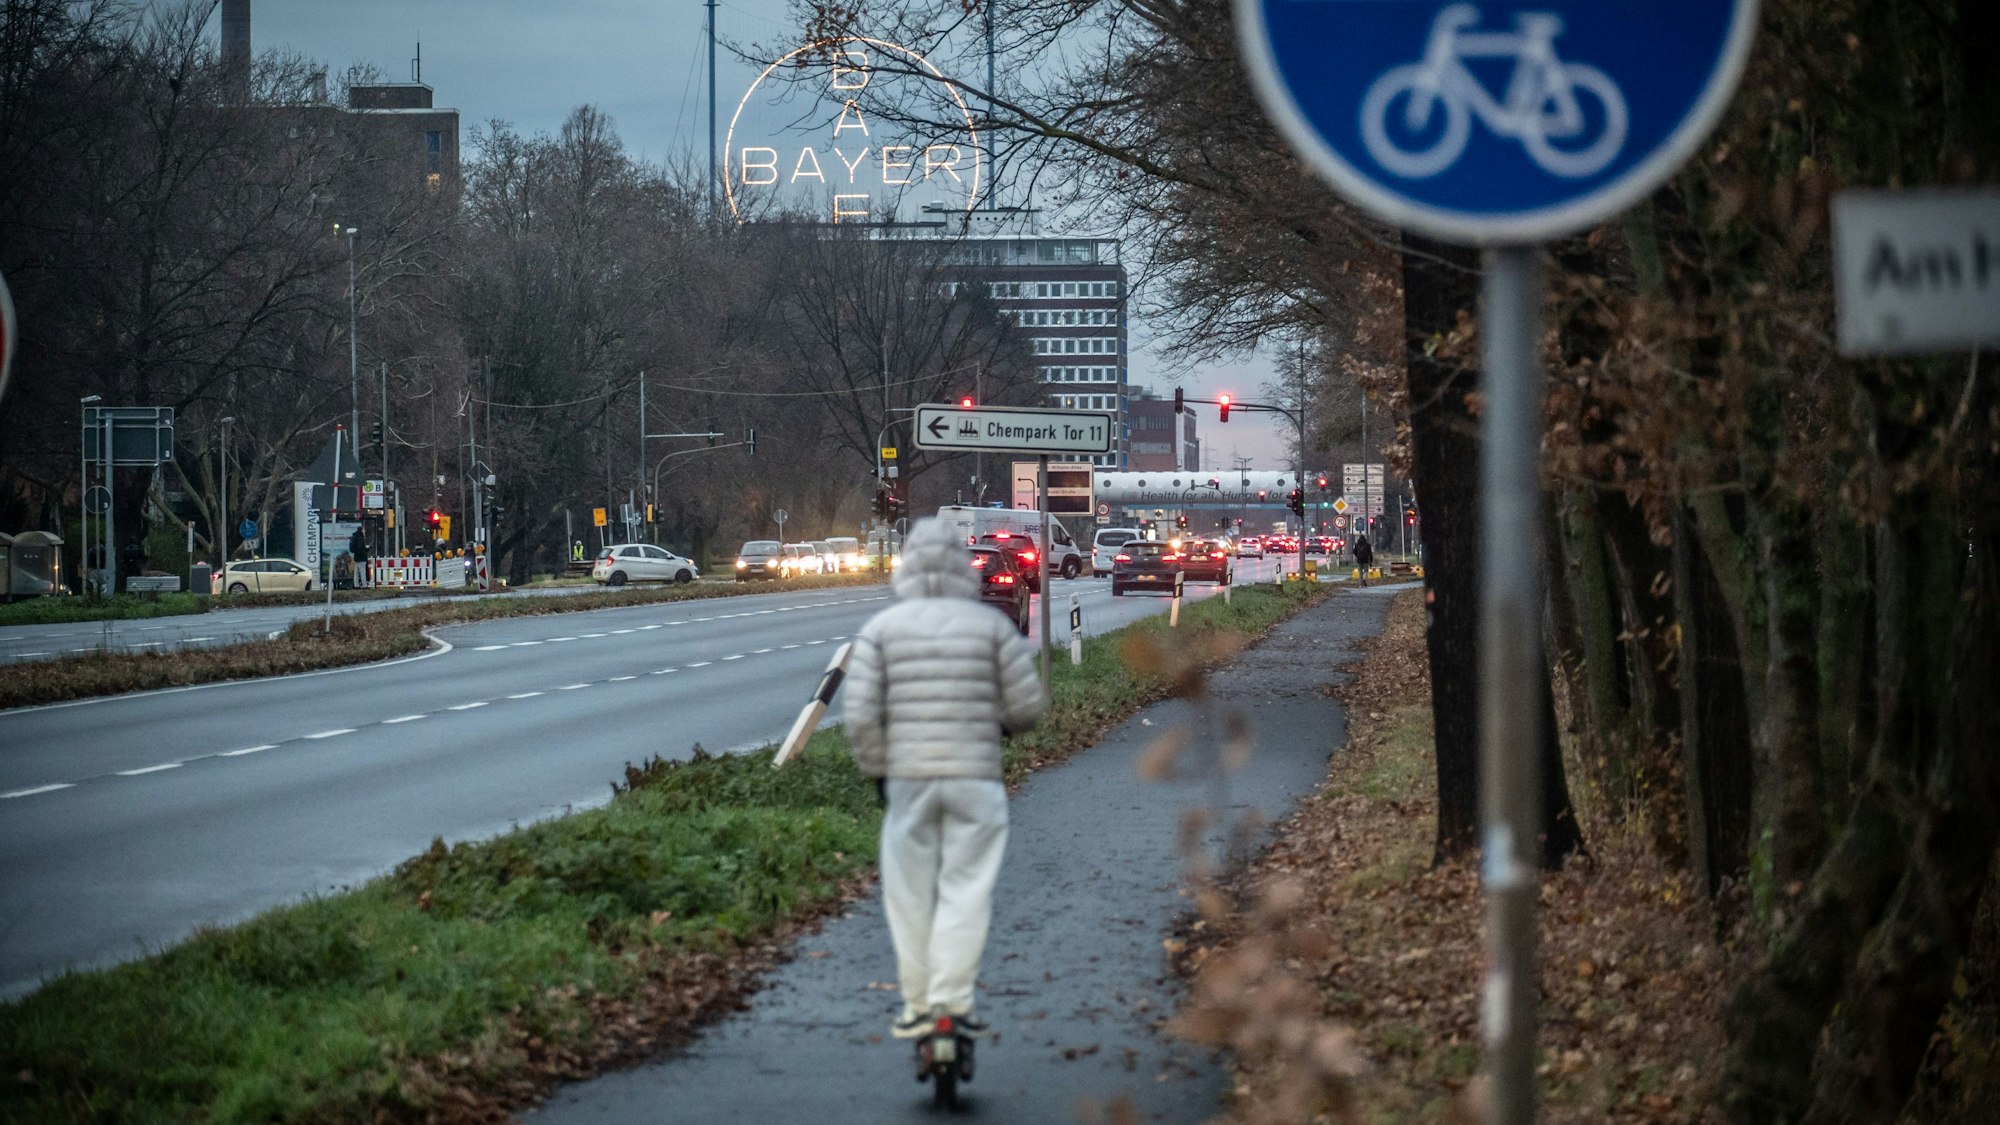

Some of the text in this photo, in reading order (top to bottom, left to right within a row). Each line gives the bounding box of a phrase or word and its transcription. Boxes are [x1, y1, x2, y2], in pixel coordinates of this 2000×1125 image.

[741, 145, 962, 184] BAYER
[987, 422, 1102, 442] Chempark Tor 11
[1141, 491, 1178, 500] Health
[1182, 491, 1197, 500] for
[1268, 491, 1284, 500] for
